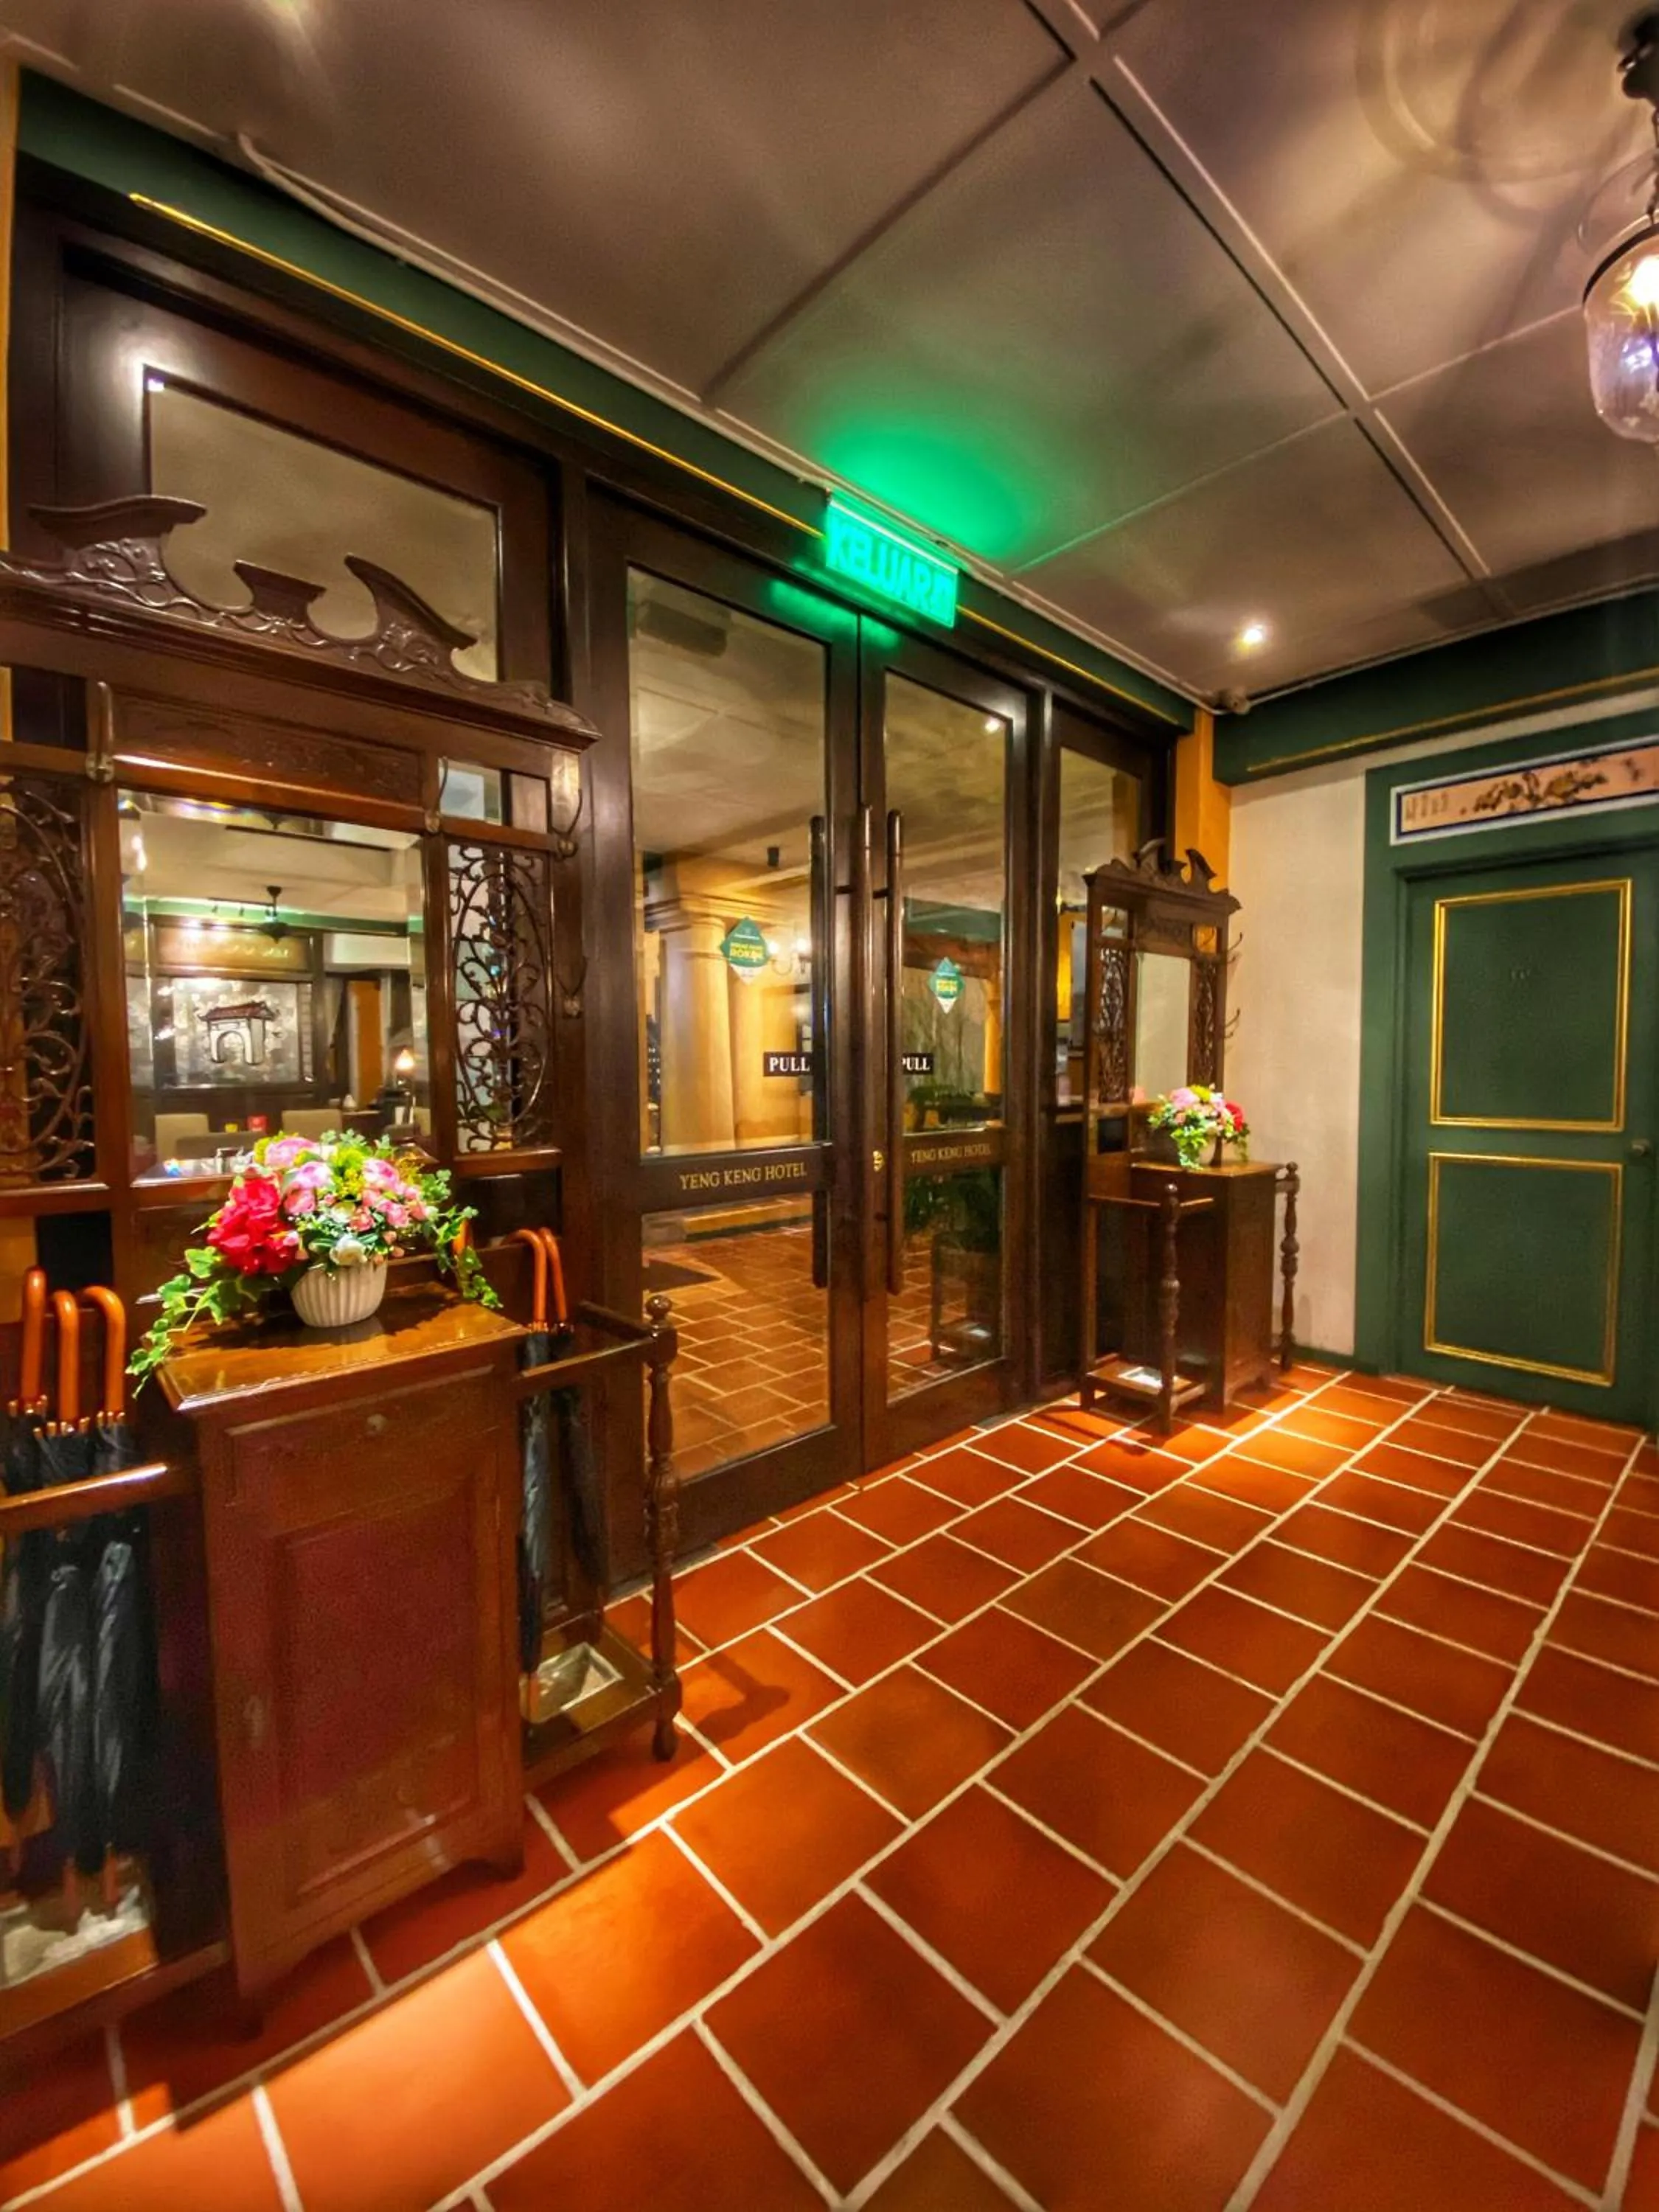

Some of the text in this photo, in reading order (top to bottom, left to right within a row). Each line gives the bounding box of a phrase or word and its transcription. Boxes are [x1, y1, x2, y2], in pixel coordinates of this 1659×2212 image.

[827, 515, 931, 611] KELUAR
[769, 1057, 810, 1072] PULL
[680, 1162, 807, 1190] YENG KENG HOTEL
